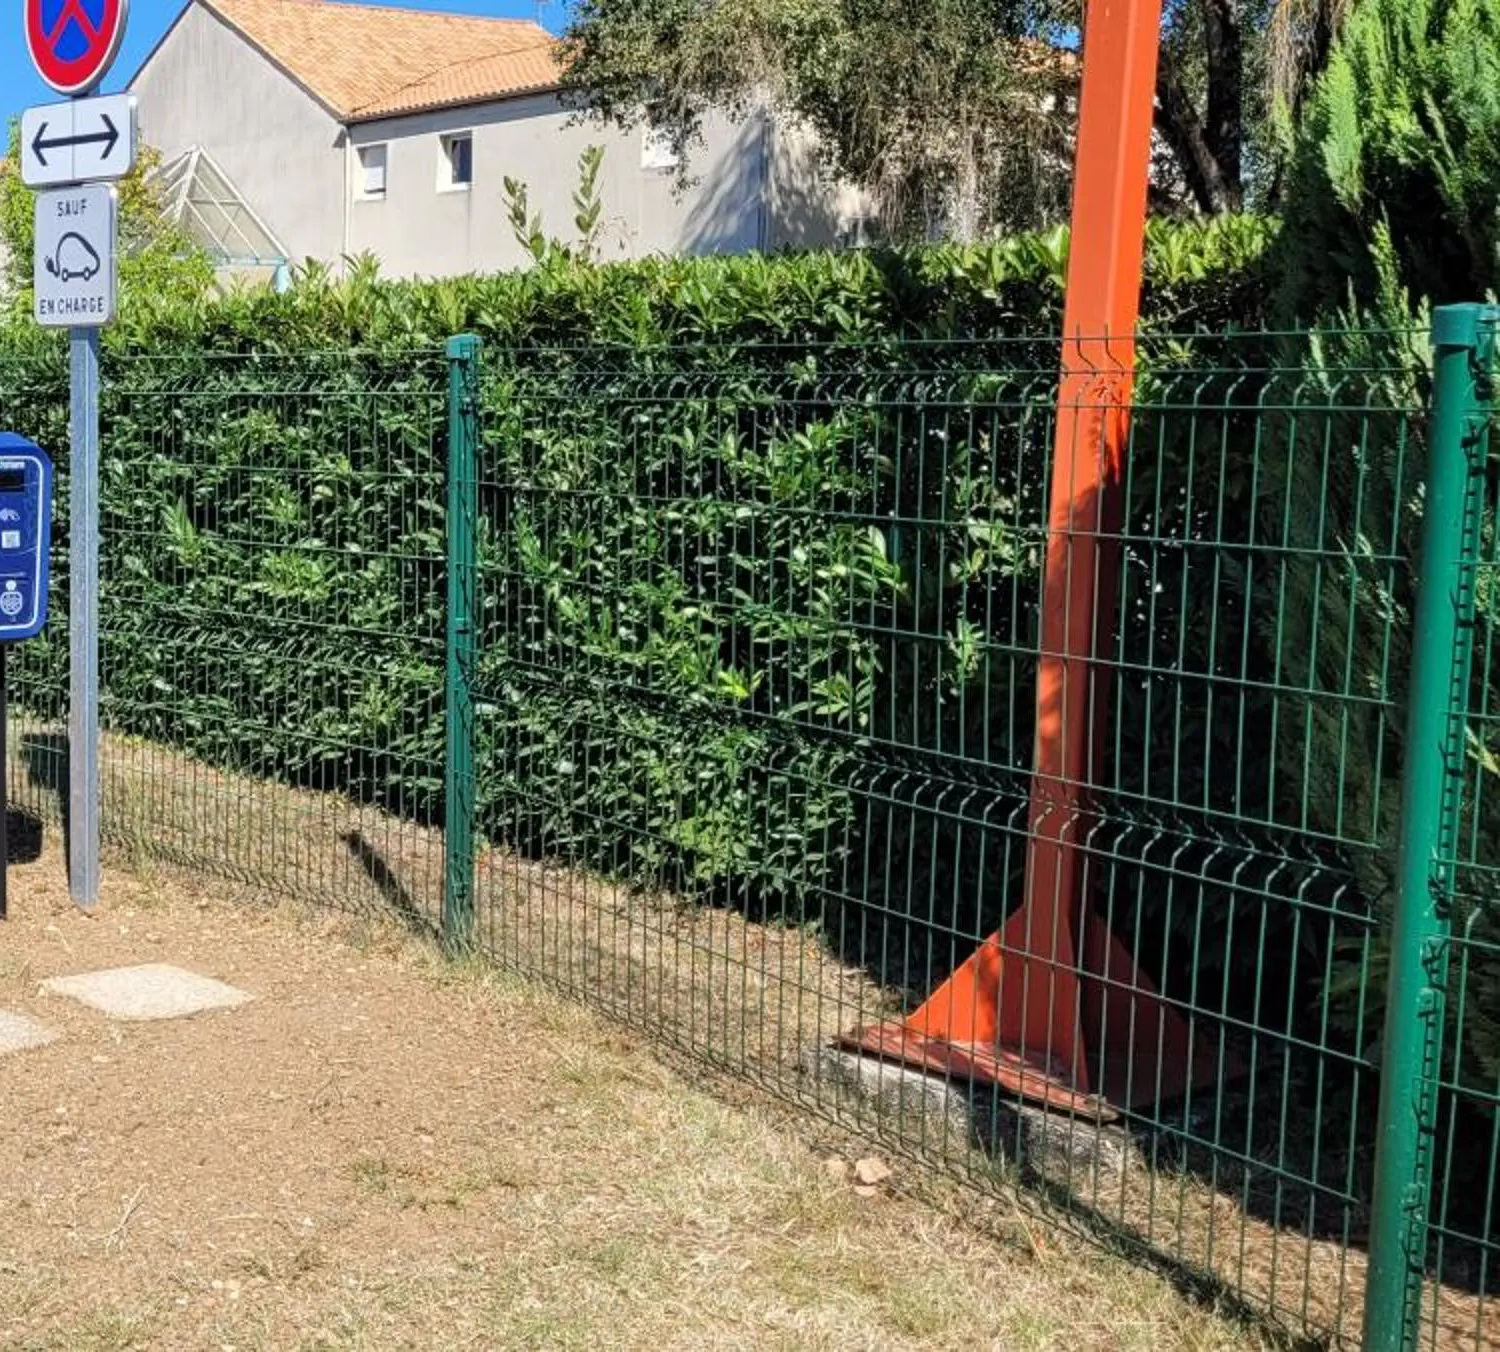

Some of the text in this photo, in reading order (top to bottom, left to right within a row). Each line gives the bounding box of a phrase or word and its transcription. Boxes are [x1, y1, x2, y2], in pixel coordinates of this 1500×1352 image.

[57, 198, 87, 217] SAUF
[39, 296, 104, 315] EN CHARGE
